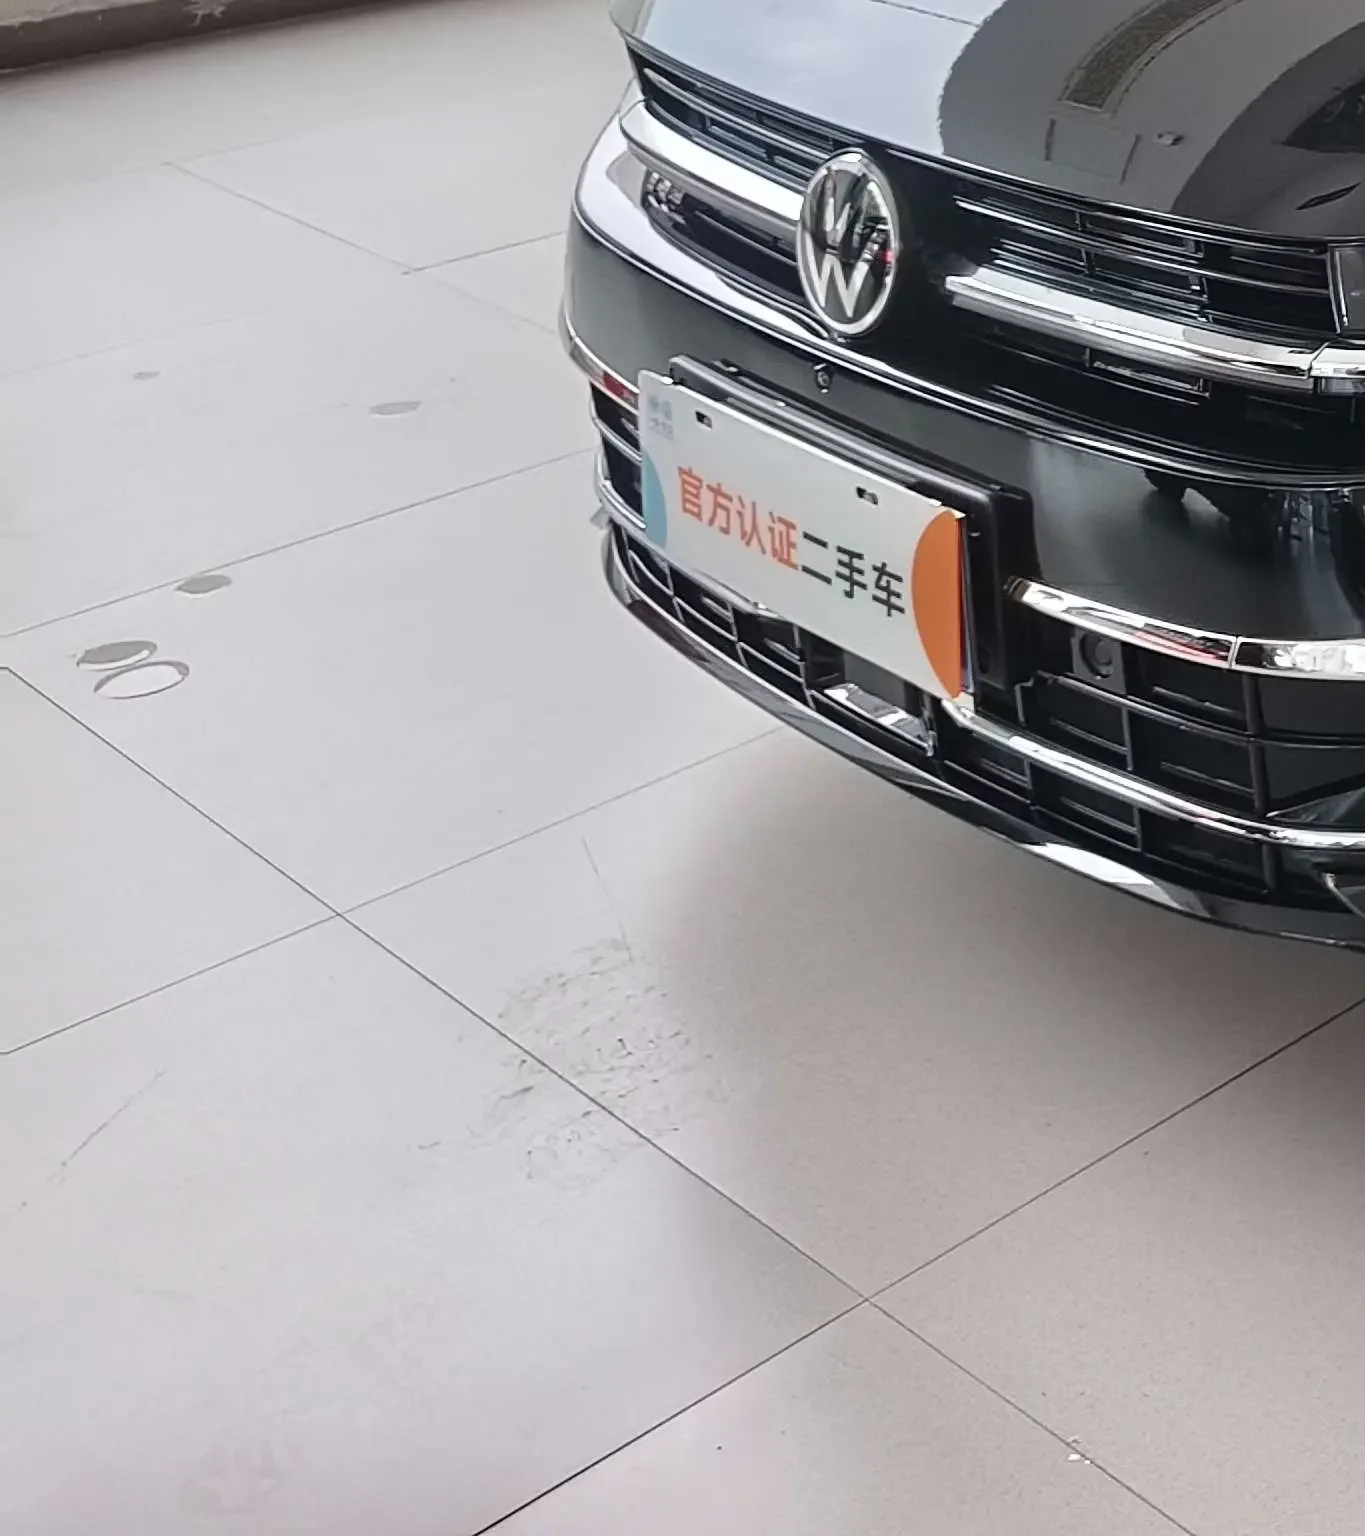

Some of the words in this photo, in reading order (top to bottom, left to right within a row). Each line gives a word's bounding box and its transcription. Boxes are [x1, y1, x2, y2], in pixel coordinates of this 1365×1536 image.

[677, 466, 906, 618] 官方认证二手车
